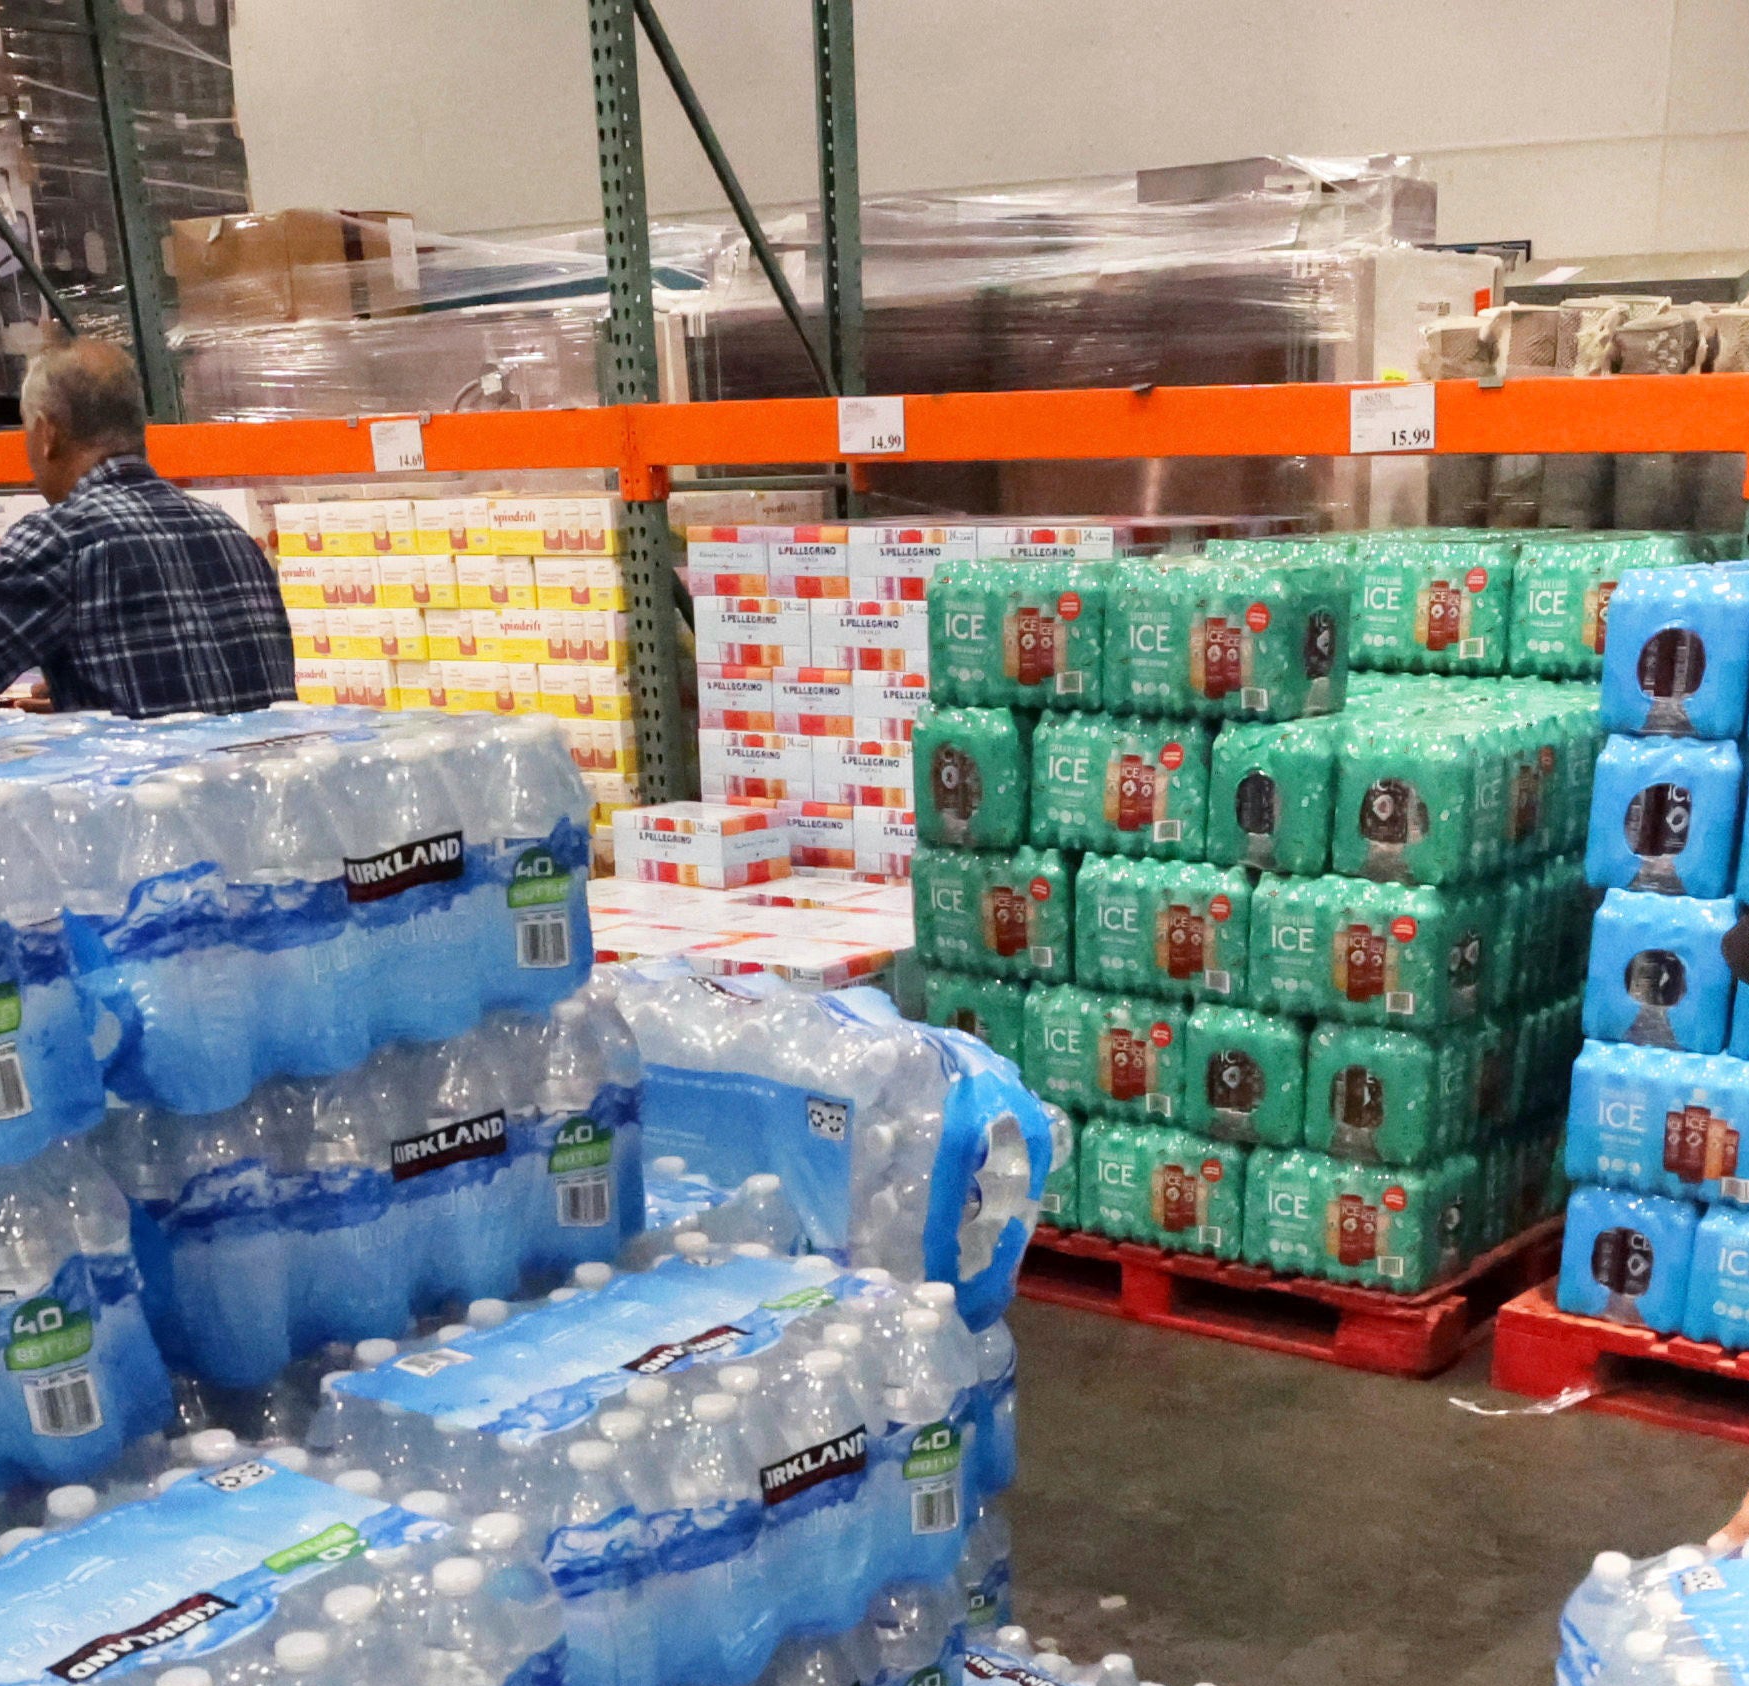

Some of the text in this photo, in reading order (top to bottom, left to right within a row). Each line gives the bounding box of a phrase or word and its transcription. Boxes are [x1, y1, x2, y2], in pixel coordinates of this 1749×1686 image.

[870, 435, 901, 449] 14.99
[1390, 429, 1430, 447] 15.99
[398, 453, 422, 468] 14.69
[493, 512, 536, 523] spindrift
[778, 546, 836, 555] S.PELLEGRINO
[880, 547, 941, 556] S.PELLEGRINO
[1010, 548, 1076, 558] S.PELLEGRINO
[1363, 588, 1401, 610] ICE
[1430, 591, 1448, 602] ICE
[1528, 591, 1567, 614] ICE
[499, 620, 541, 632] spindrift
[721, 614, 777, 624] S.PELLEGRINO
[840, 619, 899, 628] S.PELLEGRINO
[945, 613, 985, 640] ICE
[1020, 619, 1038, 631] ICE
[1130, 625, 1173, 652] ICE
[1205, 630, 1225, 642] ICE
[707, 682, 762, 691] S.PELLEGRINO
[783, 686, 840, 696] S.PELLEGRINO
[726, 749, 781, 759] S.PELLEGRINO
[842, 756, 900, 768] S.PELLEGRINO
[1048, 757, 1089, 784] ICE
[1122, 766, 1141, 778] ICE
[1668, 784, 1690, 801] IC
[639, 832, 692, 845] S.PELLEGRINO
[347, 837, 461, 886] KIRKLAND
[514, 857, 554, 877] 40
[931, 886, 964, 912] ICE
[1098, 907, 1140, 932] ICE
[1169, 915, 1188, 928] ICE
[1271, 926, 1314, 952] ICE
[1351, 937, 1368, 948] ICE
[1044, 1027, 1080, 1053] ICE
[1220, 1051, 1236, 1064] IC
[1598, 1102, 1646, 1130] ICE
[1686, 1115, 1708, 1131] ICE
[393, 1116, 505, 1165] KIRKLAND
[557, 1125, 593, 1146] 40
[1097, 1159, 1135, 1187] ICE
[1164, 1171, 1182, 1186] ICE
[1268, 1189, 1310, 1218] ICE
[1340, 1202, 1363, 1218] ICE
[11, 1307, 63, 1336] 40
[911, 1428, 952, 1453] 40
[764, 1432, 866, 1491] IRKLAND
[319, 1540, 371, 1562] 40
[66, 1597, 235, 1681] KIRKLAND
